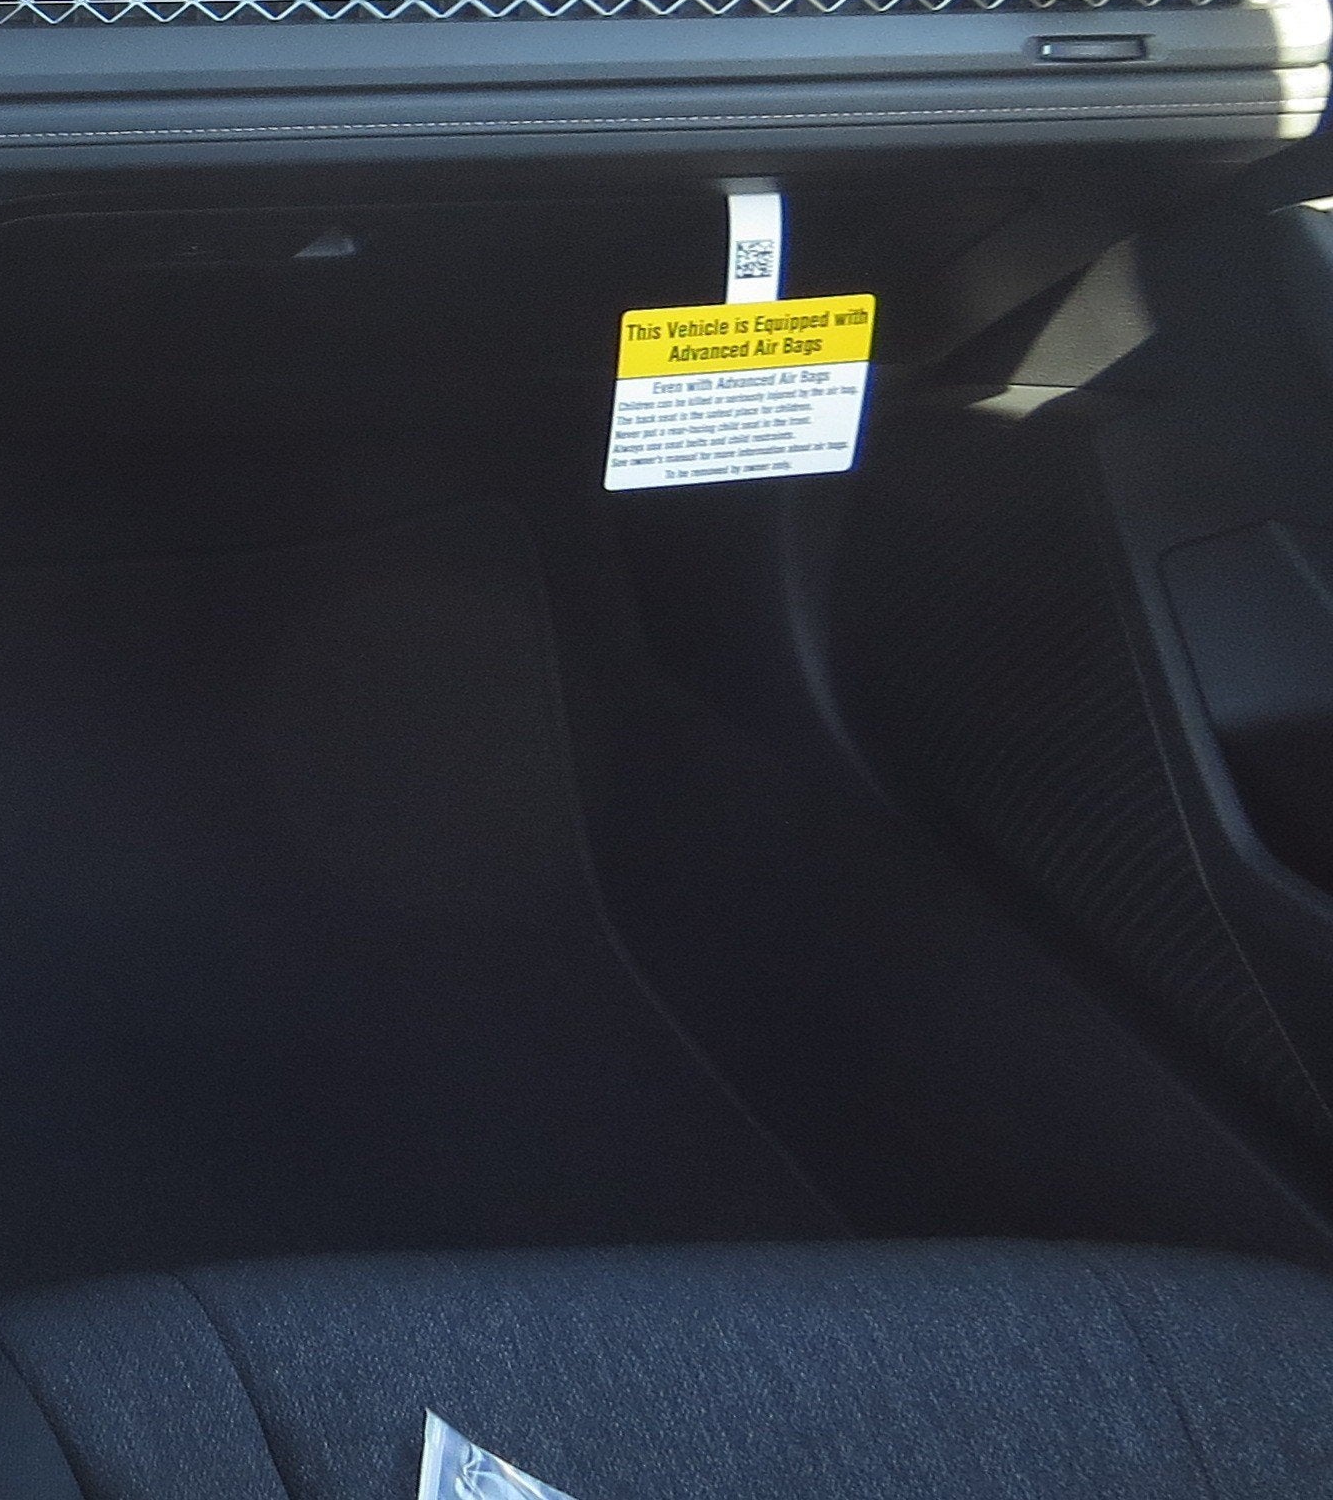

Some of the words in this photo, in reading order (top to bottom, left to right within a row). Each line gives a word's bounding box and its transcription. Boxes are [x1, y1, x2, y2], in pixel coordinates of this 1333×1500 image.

[625, 323, 662, 341] This
[666, 319, 729, 339] Vehicle
[734, 317, 749, 334] is
[754, 311, 830, 335] Equipped
[834, 308, 869, 326] with
[667, 341, 750, 362] Advanced
[753, 339, 779, 356] Air
[783, 337, 823, 355] Bags
[652, 381, 684, 394] Even
